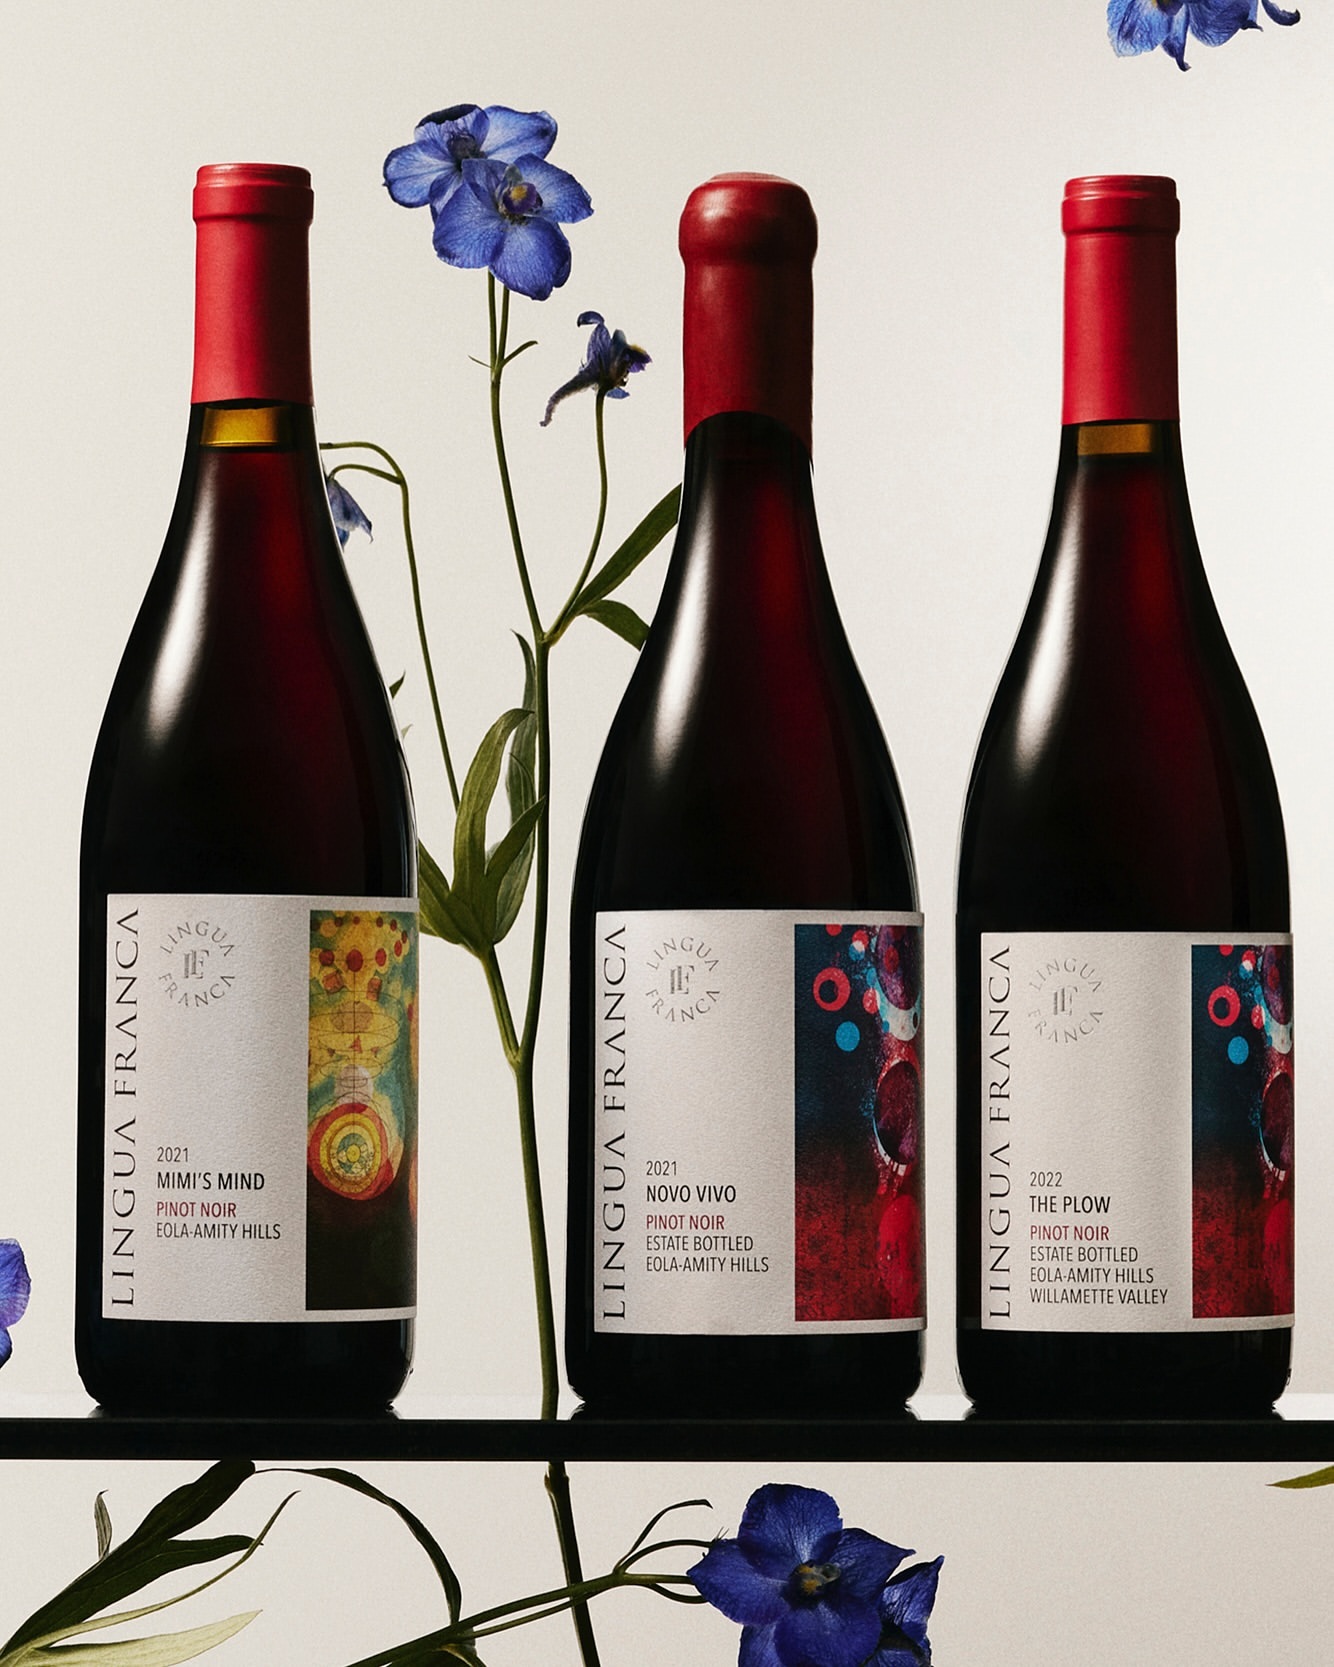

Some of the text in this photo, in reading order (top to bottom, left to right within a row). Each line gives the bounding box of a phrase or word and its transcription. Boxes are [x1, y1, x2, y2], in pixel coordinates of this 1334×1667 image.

[159, 920, 235, 957] LINGUA
[646, 936, 720, 972] LINGUA
[1029, 958, 1102, 993] LINGUA
[158, 973, 236, 1007] FRANCA
[645, 988, 721, 1022] FRANCA
[1028, 1008, 1104, 1044] FRANCA
[111, 907, 139, 1307] LINGUA FRANCA
[602, 923, 627, 1320] LINGUA FRANCA
[988, 945, 1011, 1320] LINGUA FRANCA
[156, 1146, 190, 1163] 2021
[646, 1160, 677, 1176] 2021
[156, 1171, 266, 1191] MIMI'S MIND
[1030, 1171, 1063, 1187] 2022
[646, 1184, 737, 1203] NOVO VIVO
[156, 1201, 237, 1218] PINOT NOIR
[1029, 1195, 1111, 1214] THE PLOW
[156, 1222, 281, 1240] EOLA-AMITY HILLS
[646, 1214, 725, 1231] PINOT NOIR
[1030, 1225, 1110, 1241] PINOT NOIR
[646, 1235, 754, 1252] ESTATE BOTTLED
[1030, 1246, 1138, 1263] ESTATE BOTTLED
[646, 1256, 770, 1273] EOLA-AMITY HILLS
[1030, 1266, 1155, 1284] EOLA-AMITY HILLS
[1029, 1288, 1169, 1305] WILLAMETTE VALLEY
